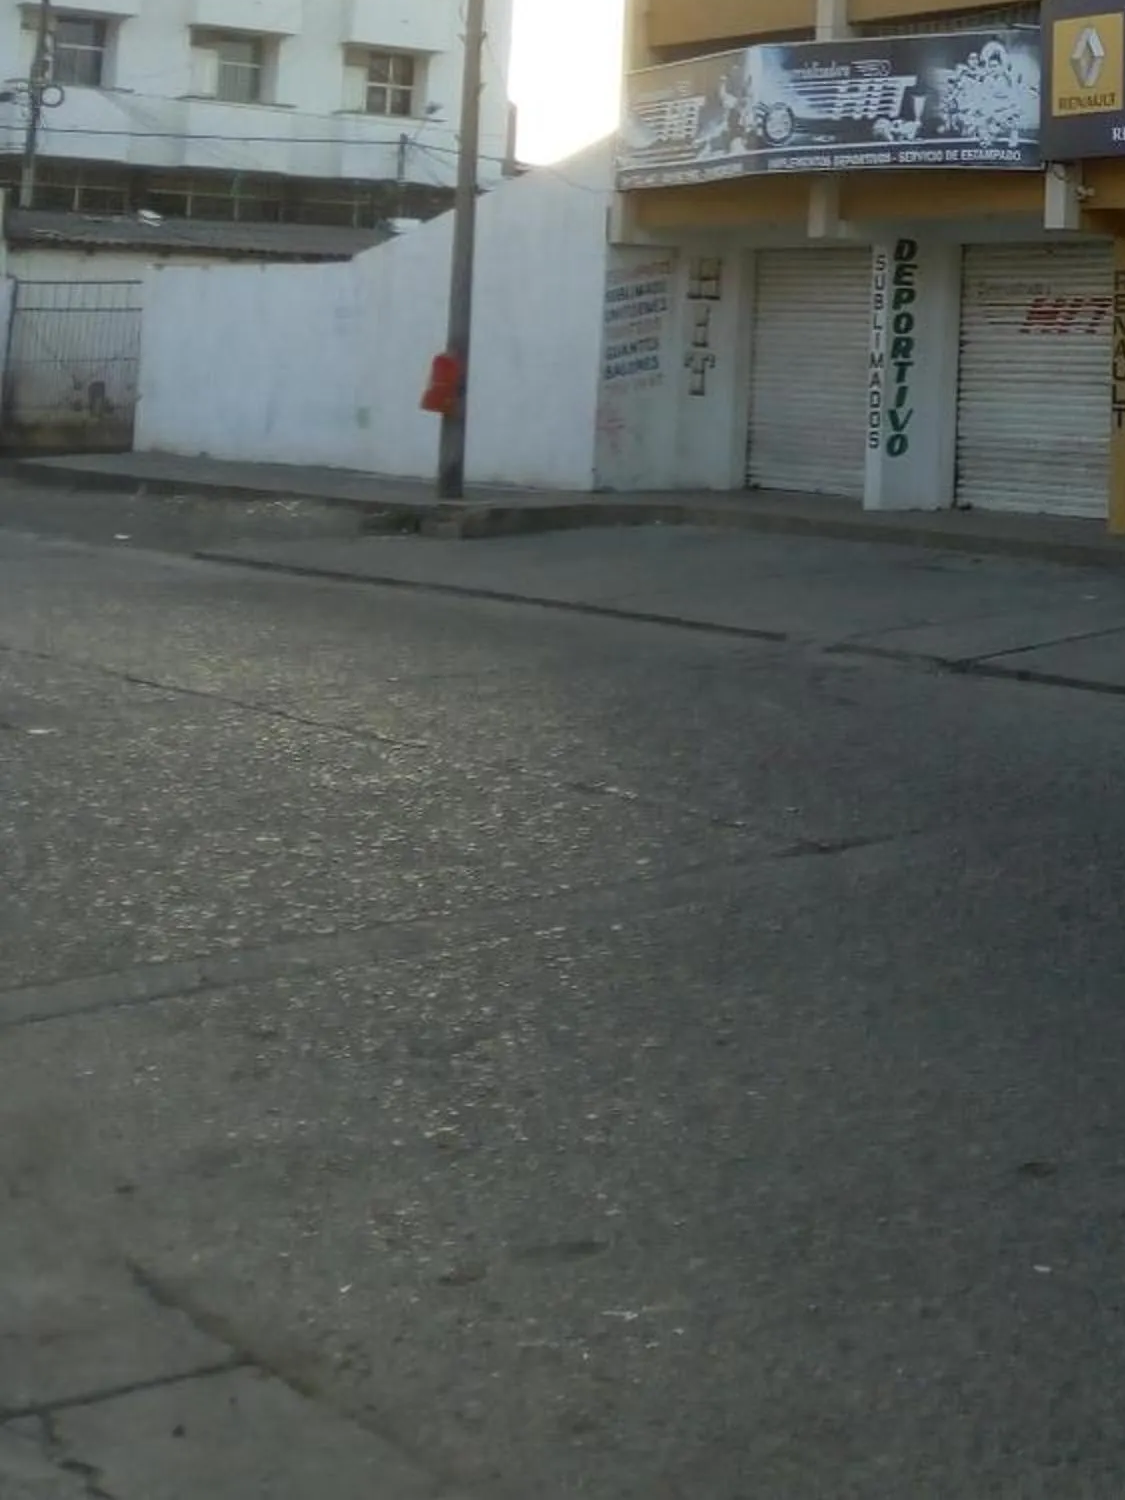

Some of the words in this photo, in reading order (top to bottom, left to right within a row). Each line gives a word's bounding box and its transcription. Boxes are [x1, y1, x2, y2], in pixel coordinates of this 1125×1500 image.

[1057, 91, 1117, 112] RENAULT
[868, 254, 887, 450] SUBLIMADOS
[886, 238, 918, 458] DEPORTIVO
